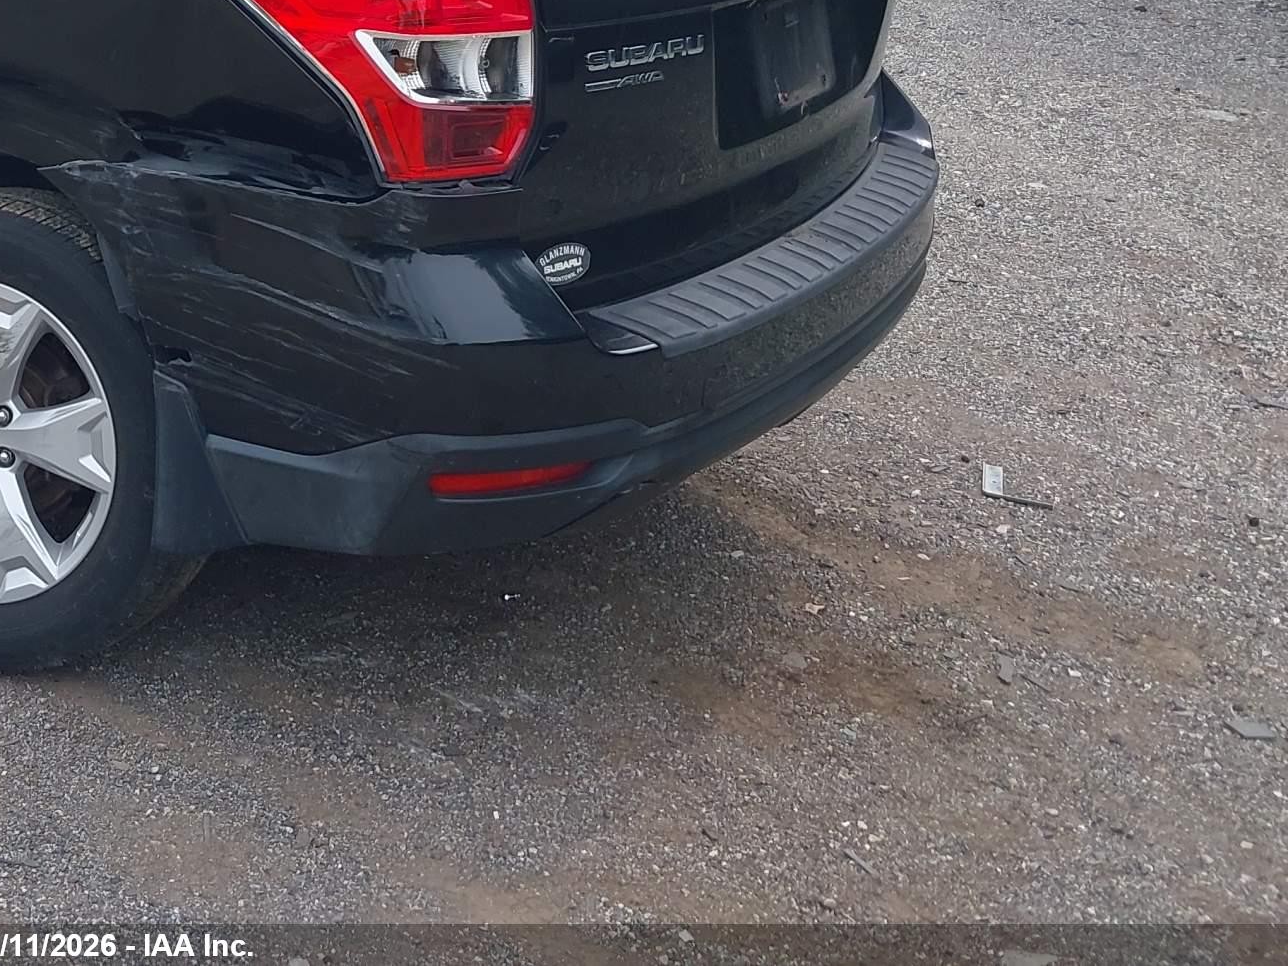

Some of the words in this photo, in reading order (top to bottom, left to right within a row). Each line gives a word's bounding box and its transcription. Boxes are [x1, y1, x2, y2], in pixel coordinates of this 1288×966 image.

[584, 34, 705, 72] SUBARU
[617, 70, 665, 88] AWD
[539, 245, 585, 266] GLANZMANN
[543, 256, 582, 275] SUBARU
